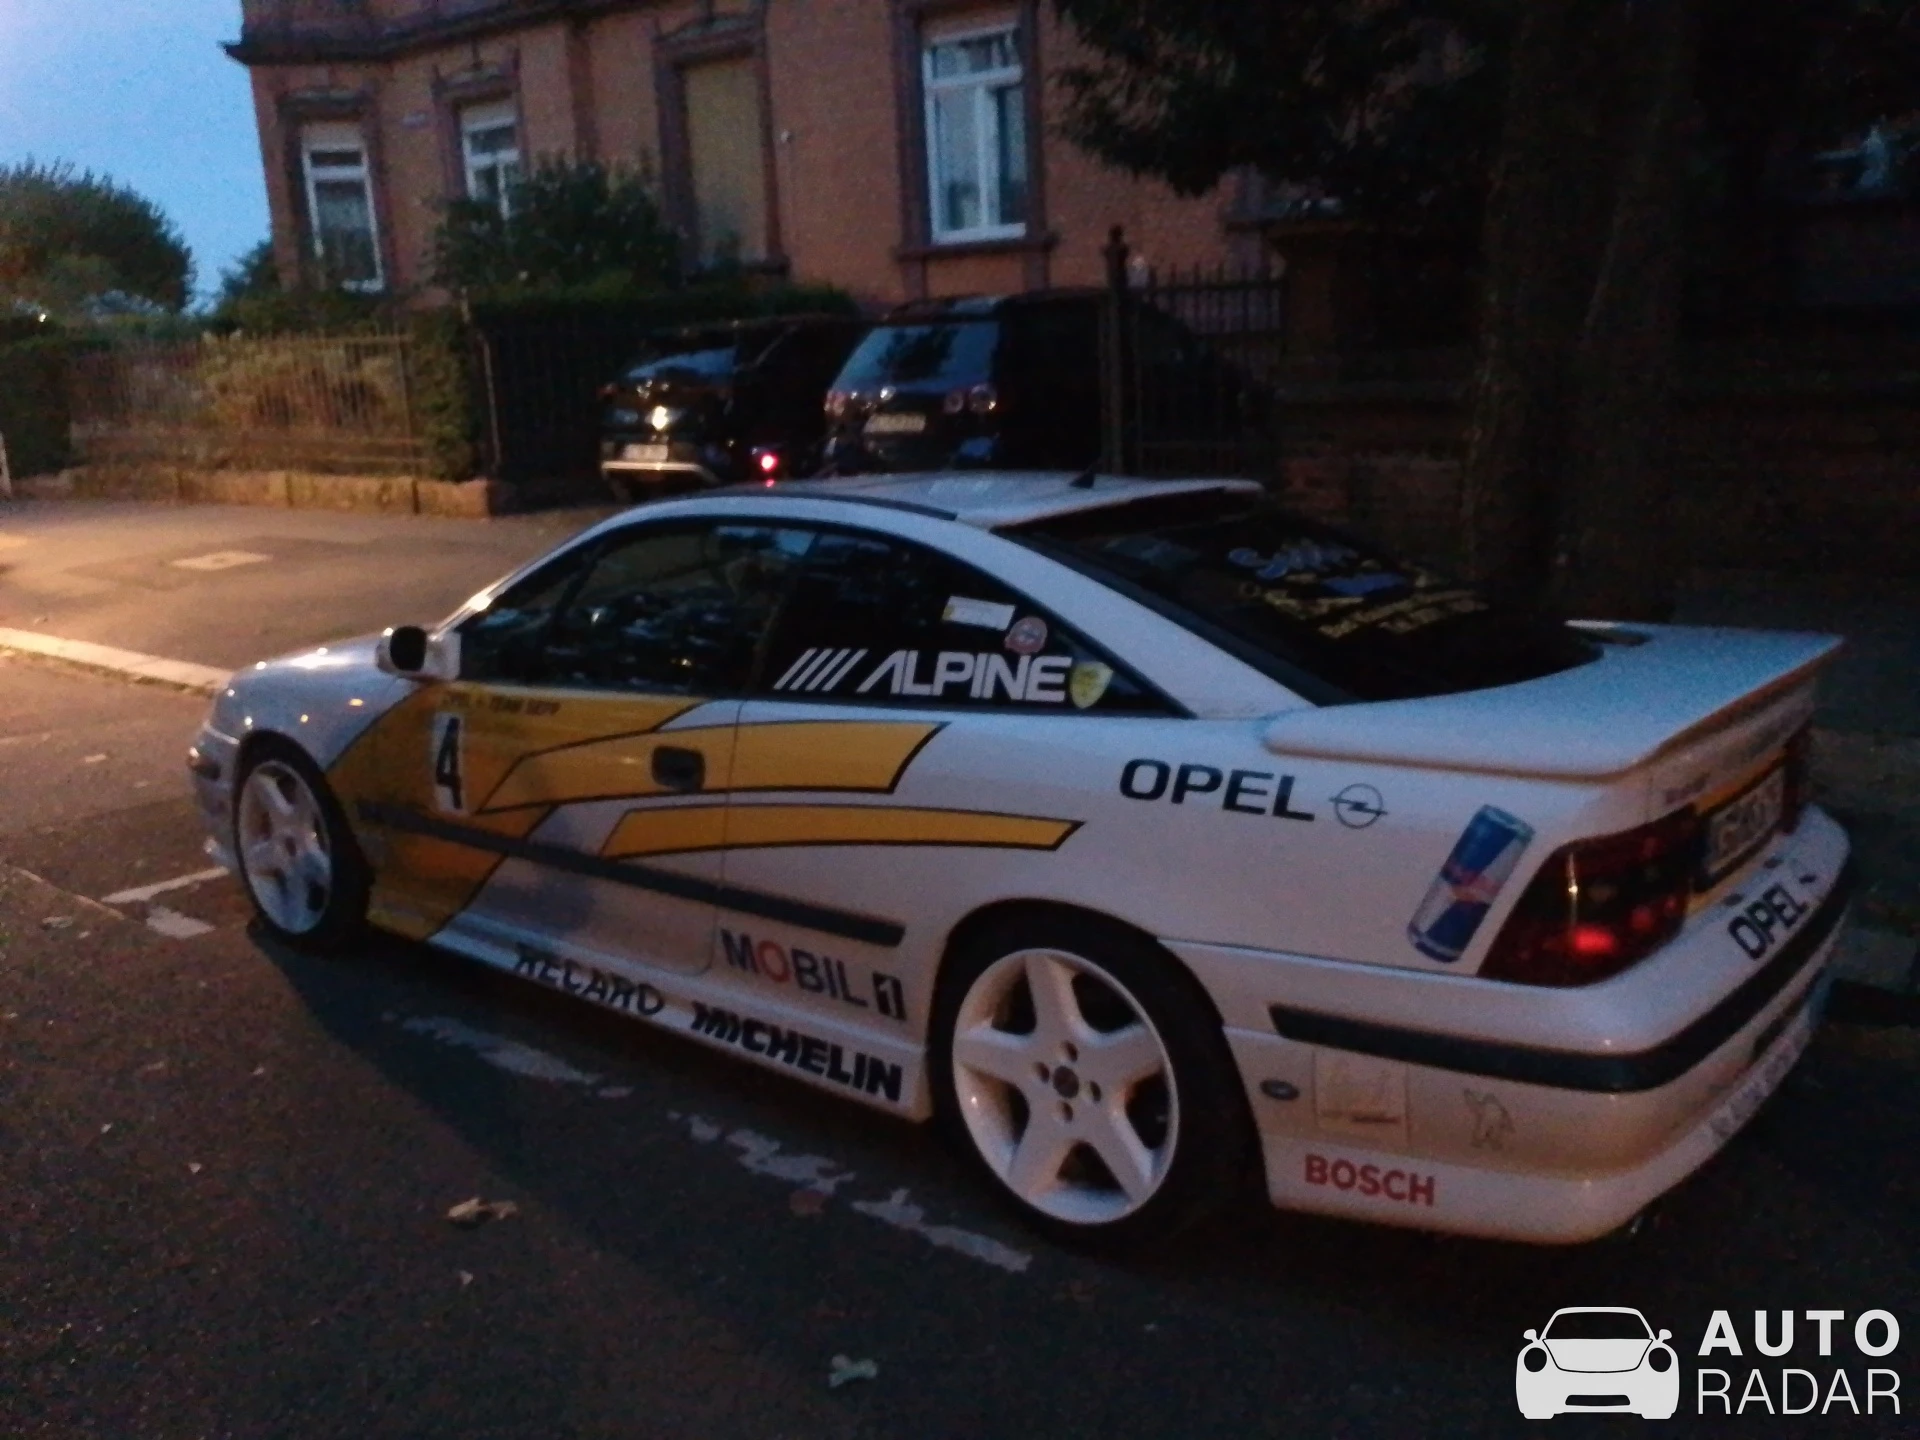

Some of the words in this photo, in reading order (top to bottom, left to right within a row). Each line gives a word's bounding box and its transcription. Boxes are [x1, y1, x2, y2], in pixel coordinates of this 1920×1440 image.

[855, 649, 1073, 702] ALPINE
[436, 717, 462, 809] 4
[1119, 758, 1315, 822] OPEL
[1728, 885, 1809, 960] OPEL
[515, 943, 665, 1016] RECARO
[720, 928, 868, 1007] MOBIL
[872, 971, 908, 1021] 1
[689, 1001, 902, 1101] MICHELIN
[1305, 1153, 1435, 1207] BOSCH
